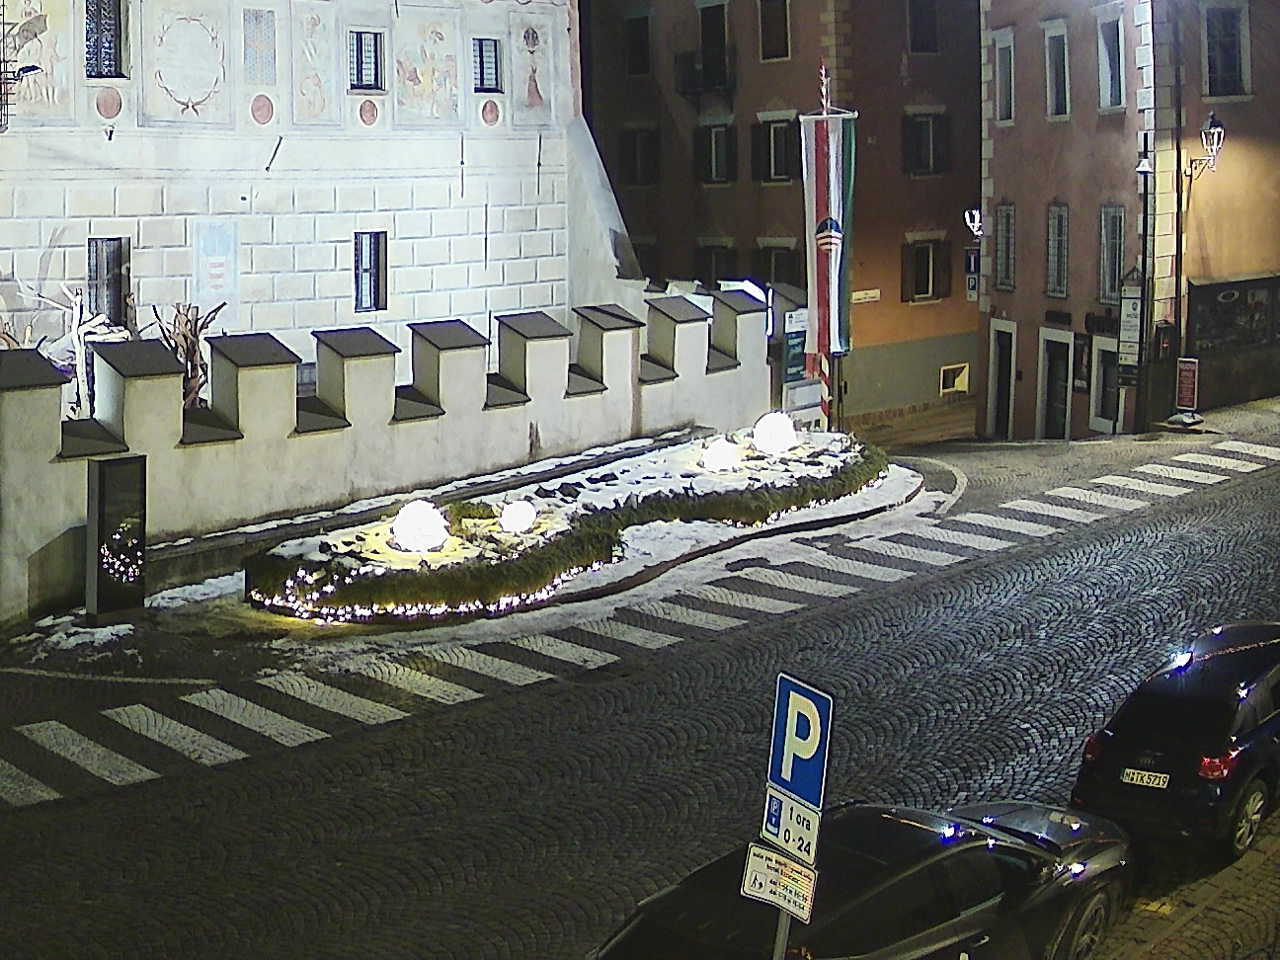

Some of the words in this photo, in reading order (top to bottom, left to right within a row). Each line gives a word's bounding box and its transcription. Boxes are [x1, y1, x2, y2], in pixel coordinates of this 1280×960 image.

[781, 691, 821, 782] P
[789, 806, 794, 821] 1
[796, 814, 811, 831] ora
